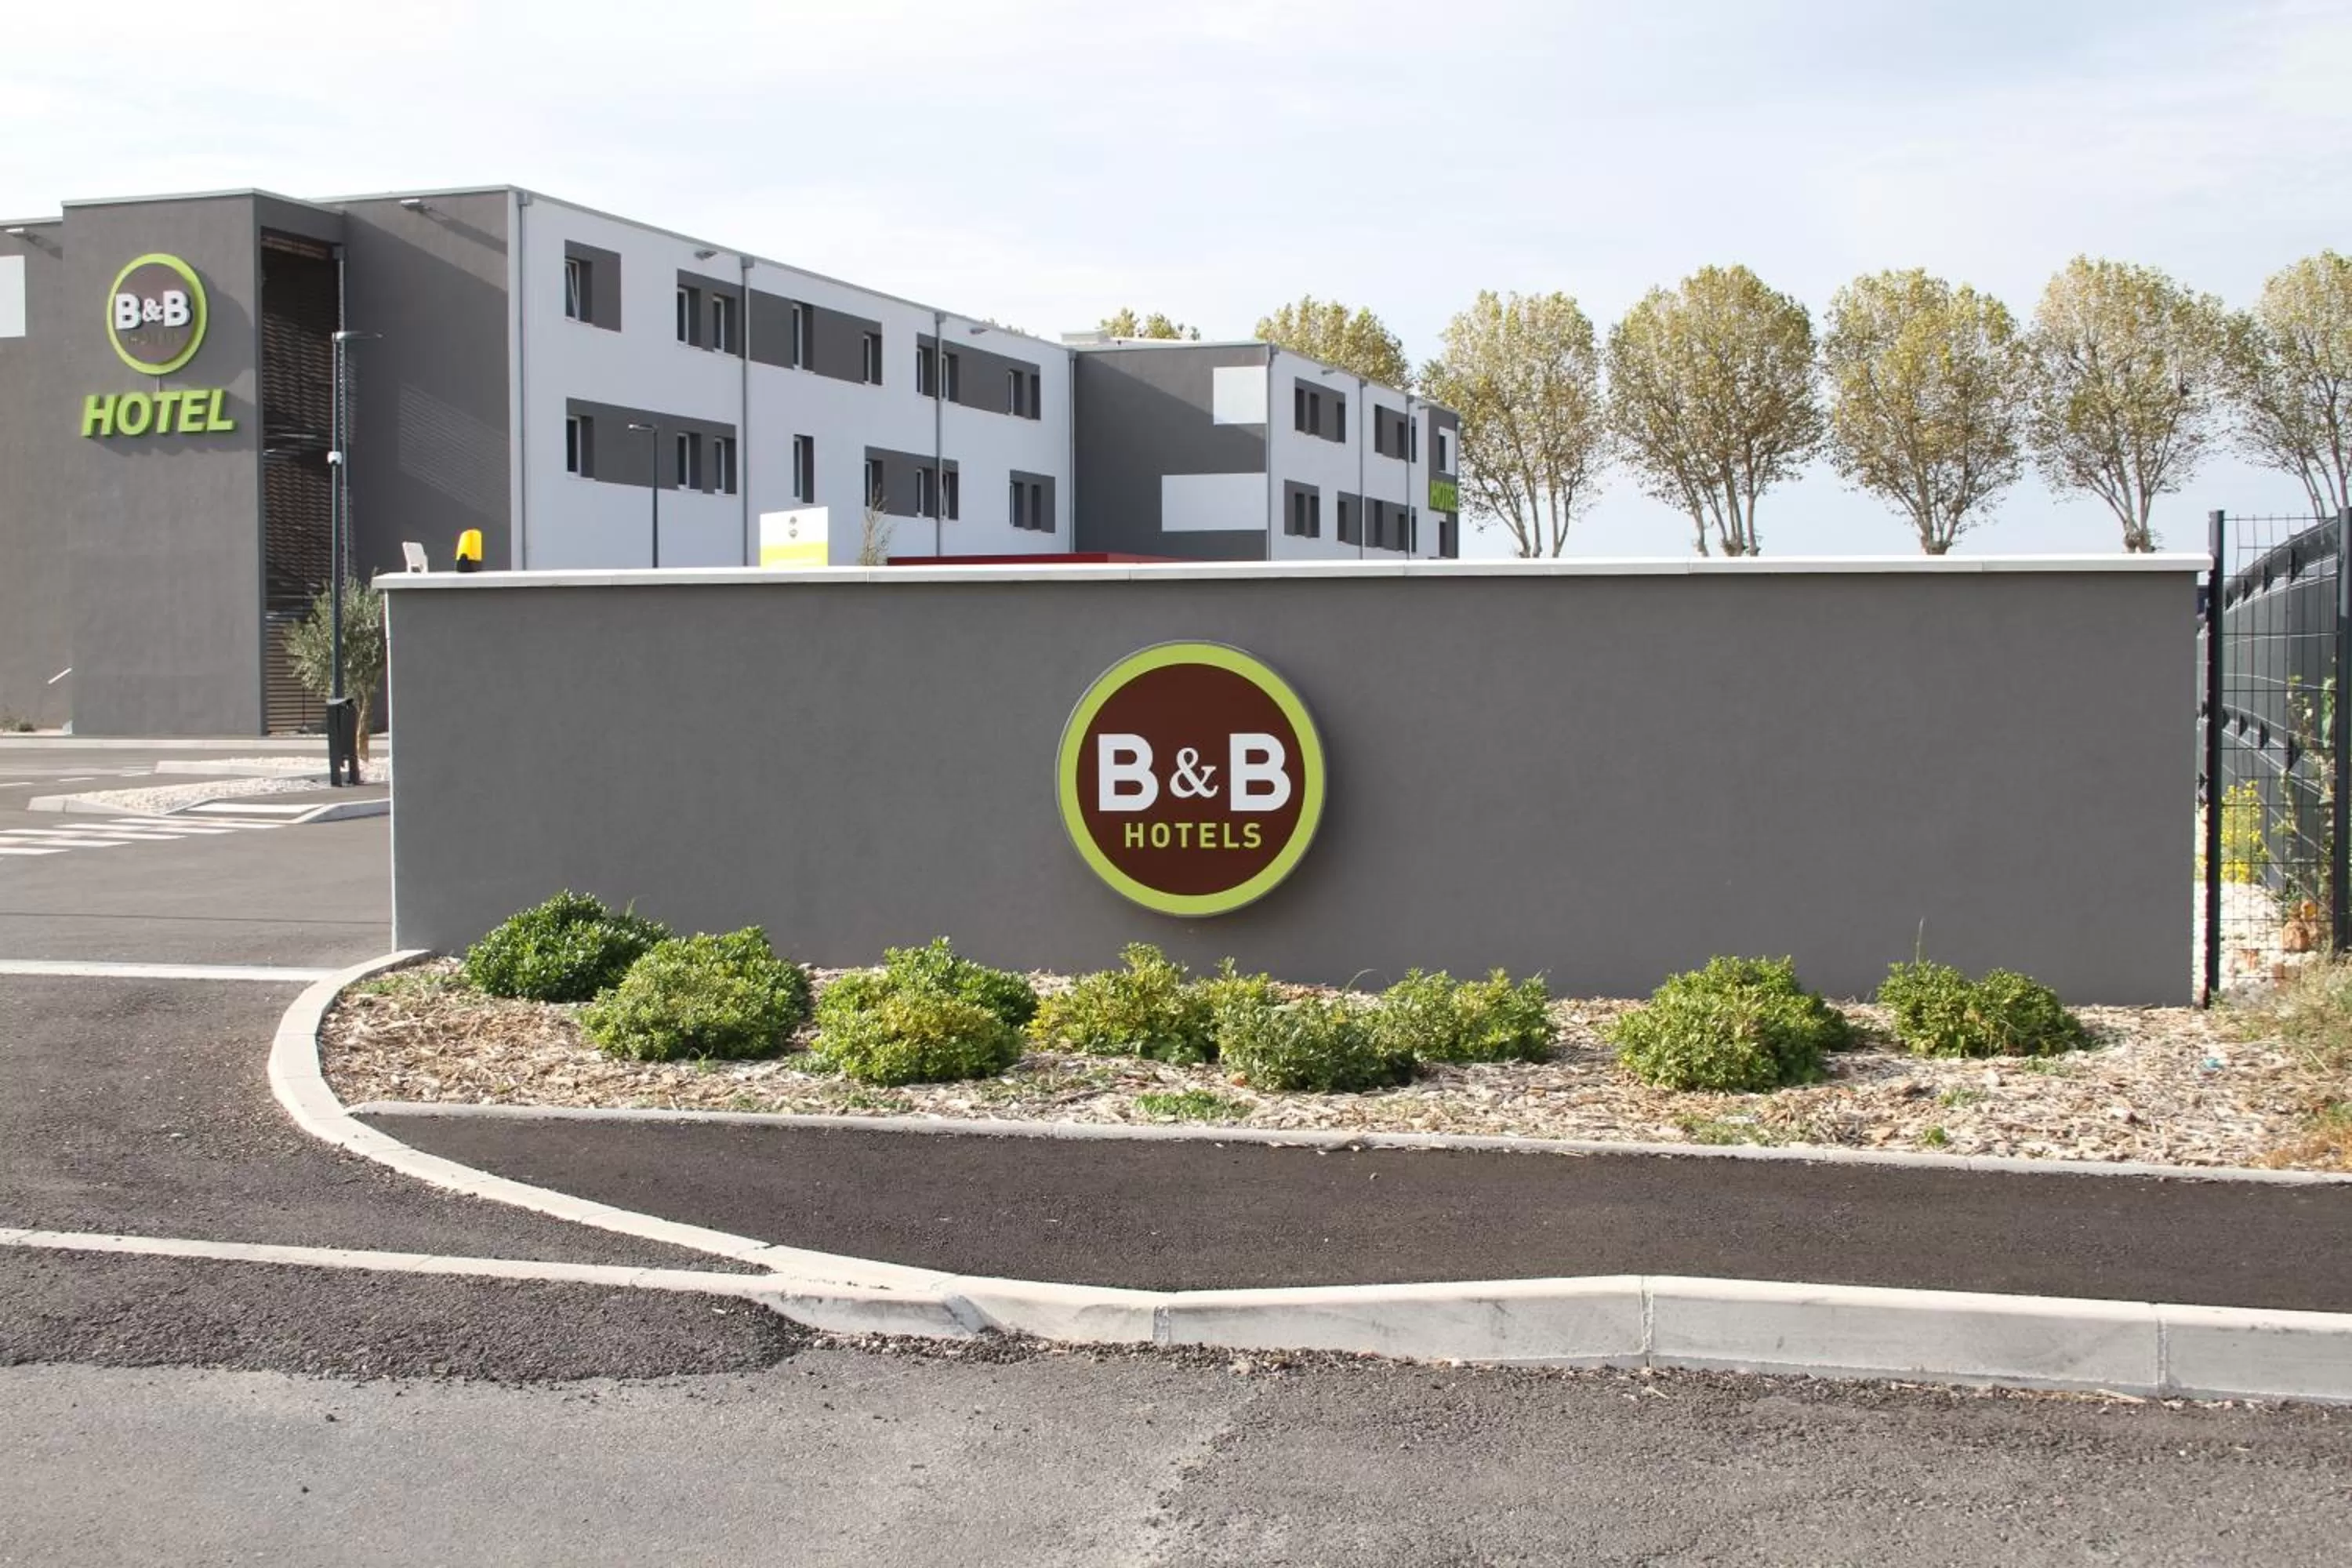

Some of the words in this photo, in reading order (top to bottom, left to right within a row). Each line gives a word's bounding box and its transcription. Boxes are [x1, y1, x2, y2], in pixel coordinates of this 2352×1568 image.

[115, 290, 191, 329] B&B
[81, 388, 234, 437] HOTEL
[1098, 733, 1291, 811] B&B
[1124, 822, 1261, 849] HOTELS
